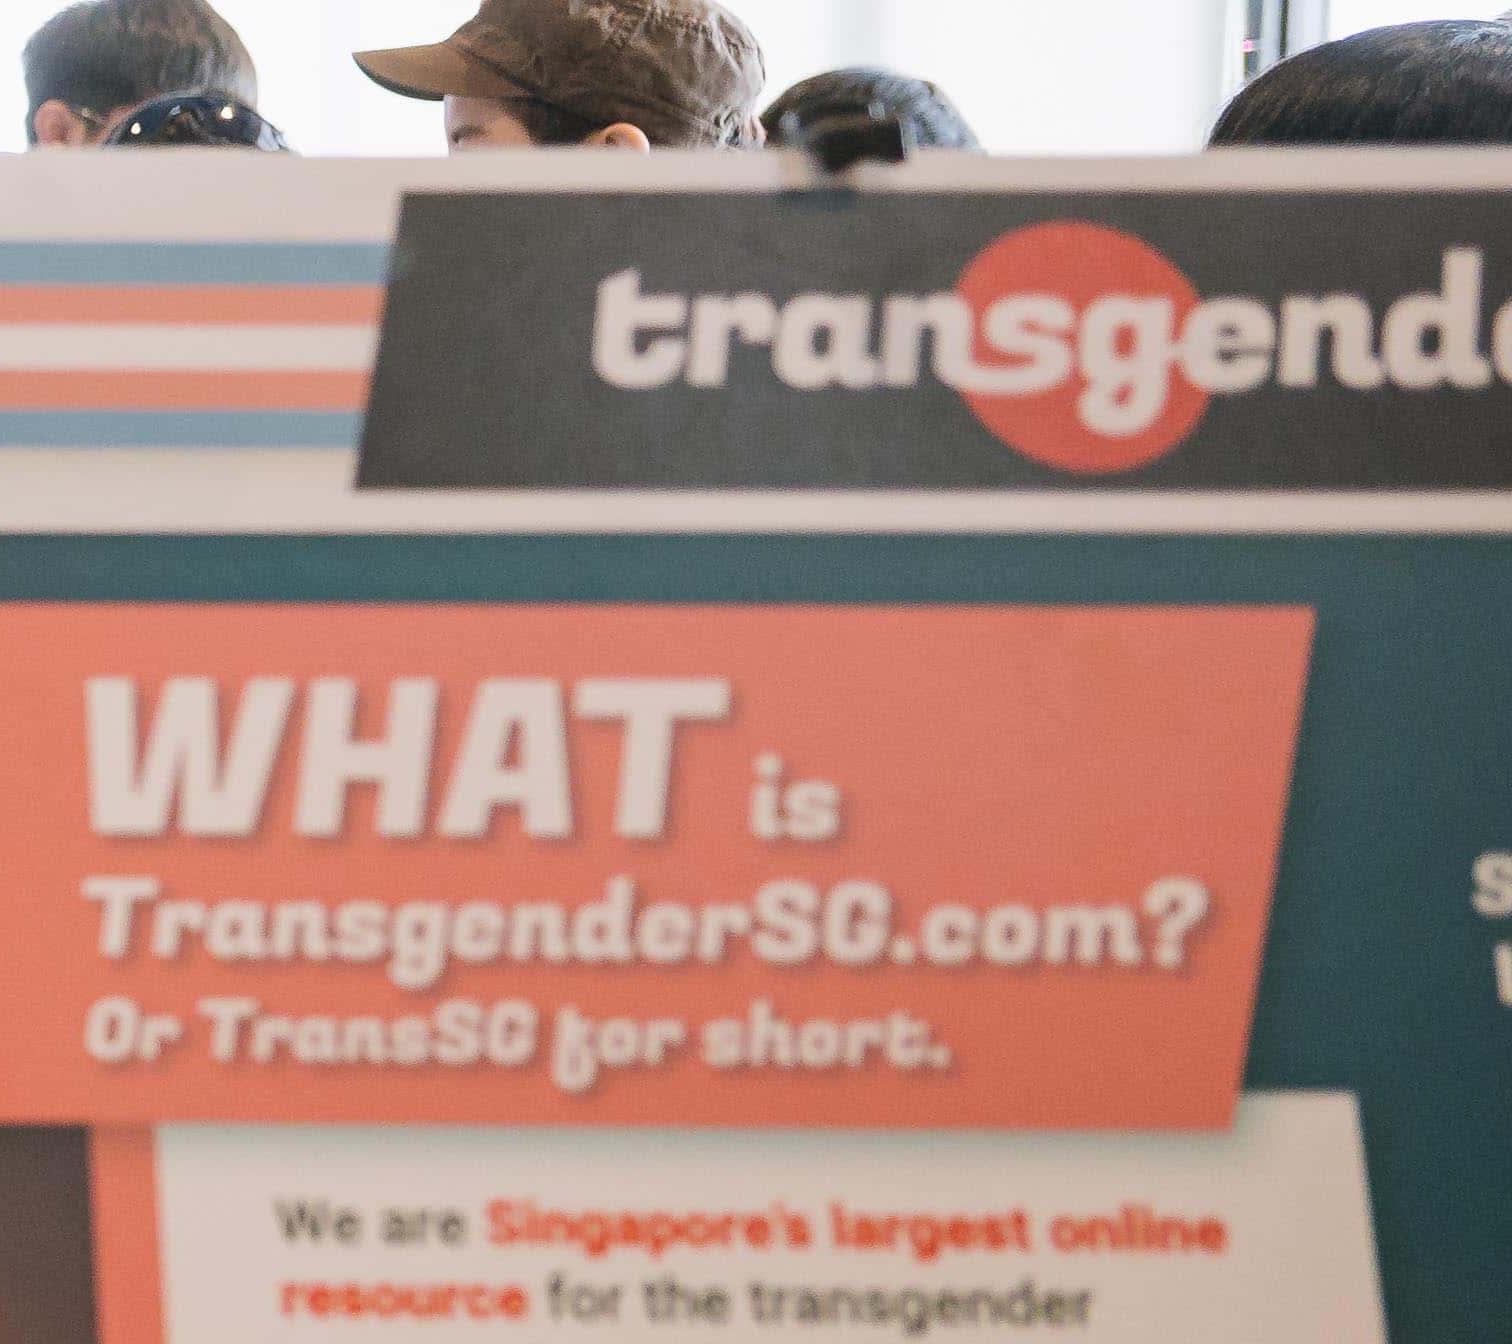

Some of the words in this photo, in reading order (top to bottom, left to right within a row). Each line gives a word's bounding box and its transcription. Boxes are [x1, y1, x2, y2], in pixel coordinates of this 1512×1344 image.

[590, 246, 1512, 439] transgend
[81, 675, 734, 840] WHAT
[747, 750, 844, 842] is
[80, 875, 1211, 992] TransgenderSG.com?
[81, 994, 183, 1065] Or
[196, 996, 539, 1065] TransSG
[548, 1000, 685, 1095] for
[700, 996, 955, 1069] short.
[271, 1197, 362, 1245] We
[378, 1207, 466, 1247] are
[483, 1196, 813, 1258] Singapore's
[829, 1201, 1033, 1263] largest
[1049, 1202, 1232, 1256] online
[277, 1276, 529, 1320] resource
[545, 1272, 622, 1322] for
[641, 1276, 732, 1325] the
[749, 1279, 1097, 1336] transgender
